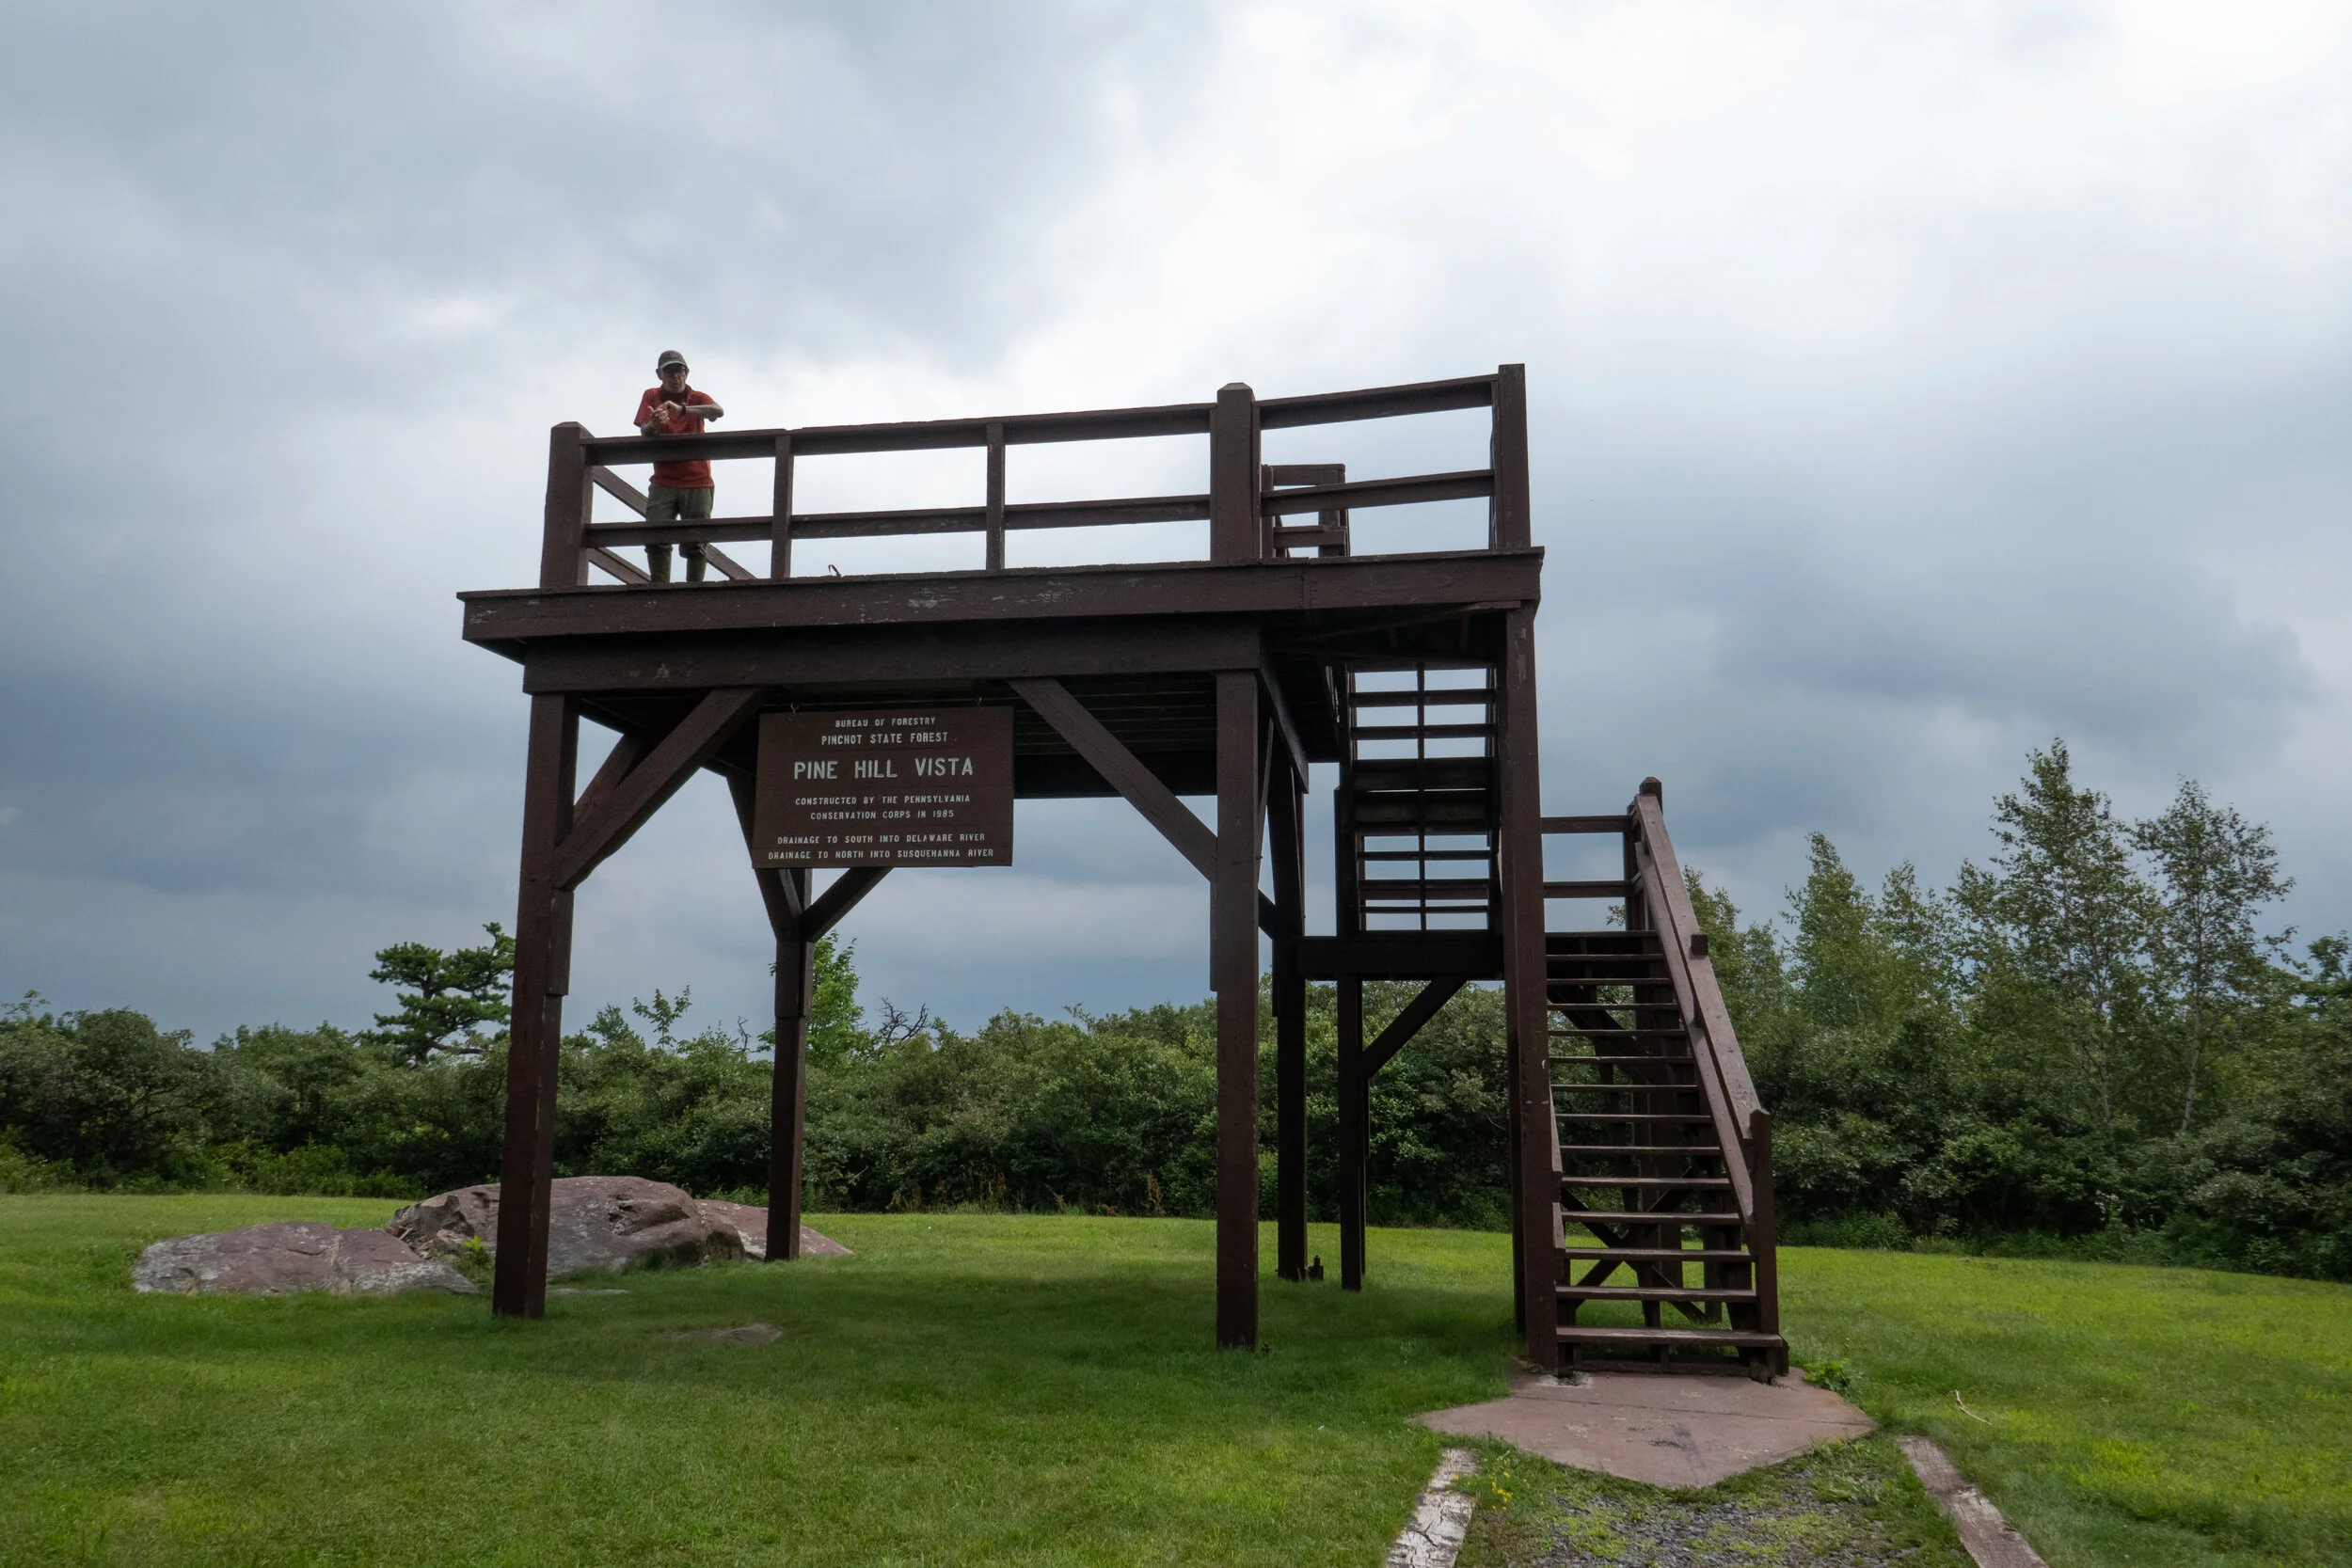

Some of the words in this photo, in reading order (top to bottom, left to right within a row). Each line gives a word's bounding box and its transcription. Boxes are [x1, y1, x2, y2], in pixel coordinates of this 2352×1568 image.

[834, 719, 868, 728] BUREAU
[874, 719, 885, 727] OF
[891, 717, 935, 726] FORESTRY
[821, 734, 863, 745] PINCHOT
[869, 733, 902, 744] STATE
[910, 732, 947, 743] FOREST
[794, 760, 838, 780] PINE
[854, 759, 898, 779] HILL
[914, 756, 974, 777] VISTA
[795, 797, 857, 806] CONSTRUCTED
[863, 796, 875, 804] BY
[882, 796, 898, 804] THE
[904, 794, 970, 804] PENNSYLVANIA
[810, 811, 877, 820] CONSERVATION
[882, 810, 911, 819] CORPS
[917, 810, 927, 818] IN
[932, 809, 954, 818] 1985
[777, 835, 819, 845] DRAINAGE
[827, 835, 838, 844] TO
[845, 835, 873, 844] SOUTH
[879, 834, 900, 843] INTO
[906, 833, 953, 843] DELAWARE
[959, 833, 985, 842] RIVER
[768, 850, 811, 861] DRAINAGE
[818, 850, 829, 859] TO
[834, 850, 864, 859] NORTH
[869, 849, 891, 859] INTO
[897, 848, 961, 858] SUSQUEHANNA
[967, 848, 993, 857] RIVER
